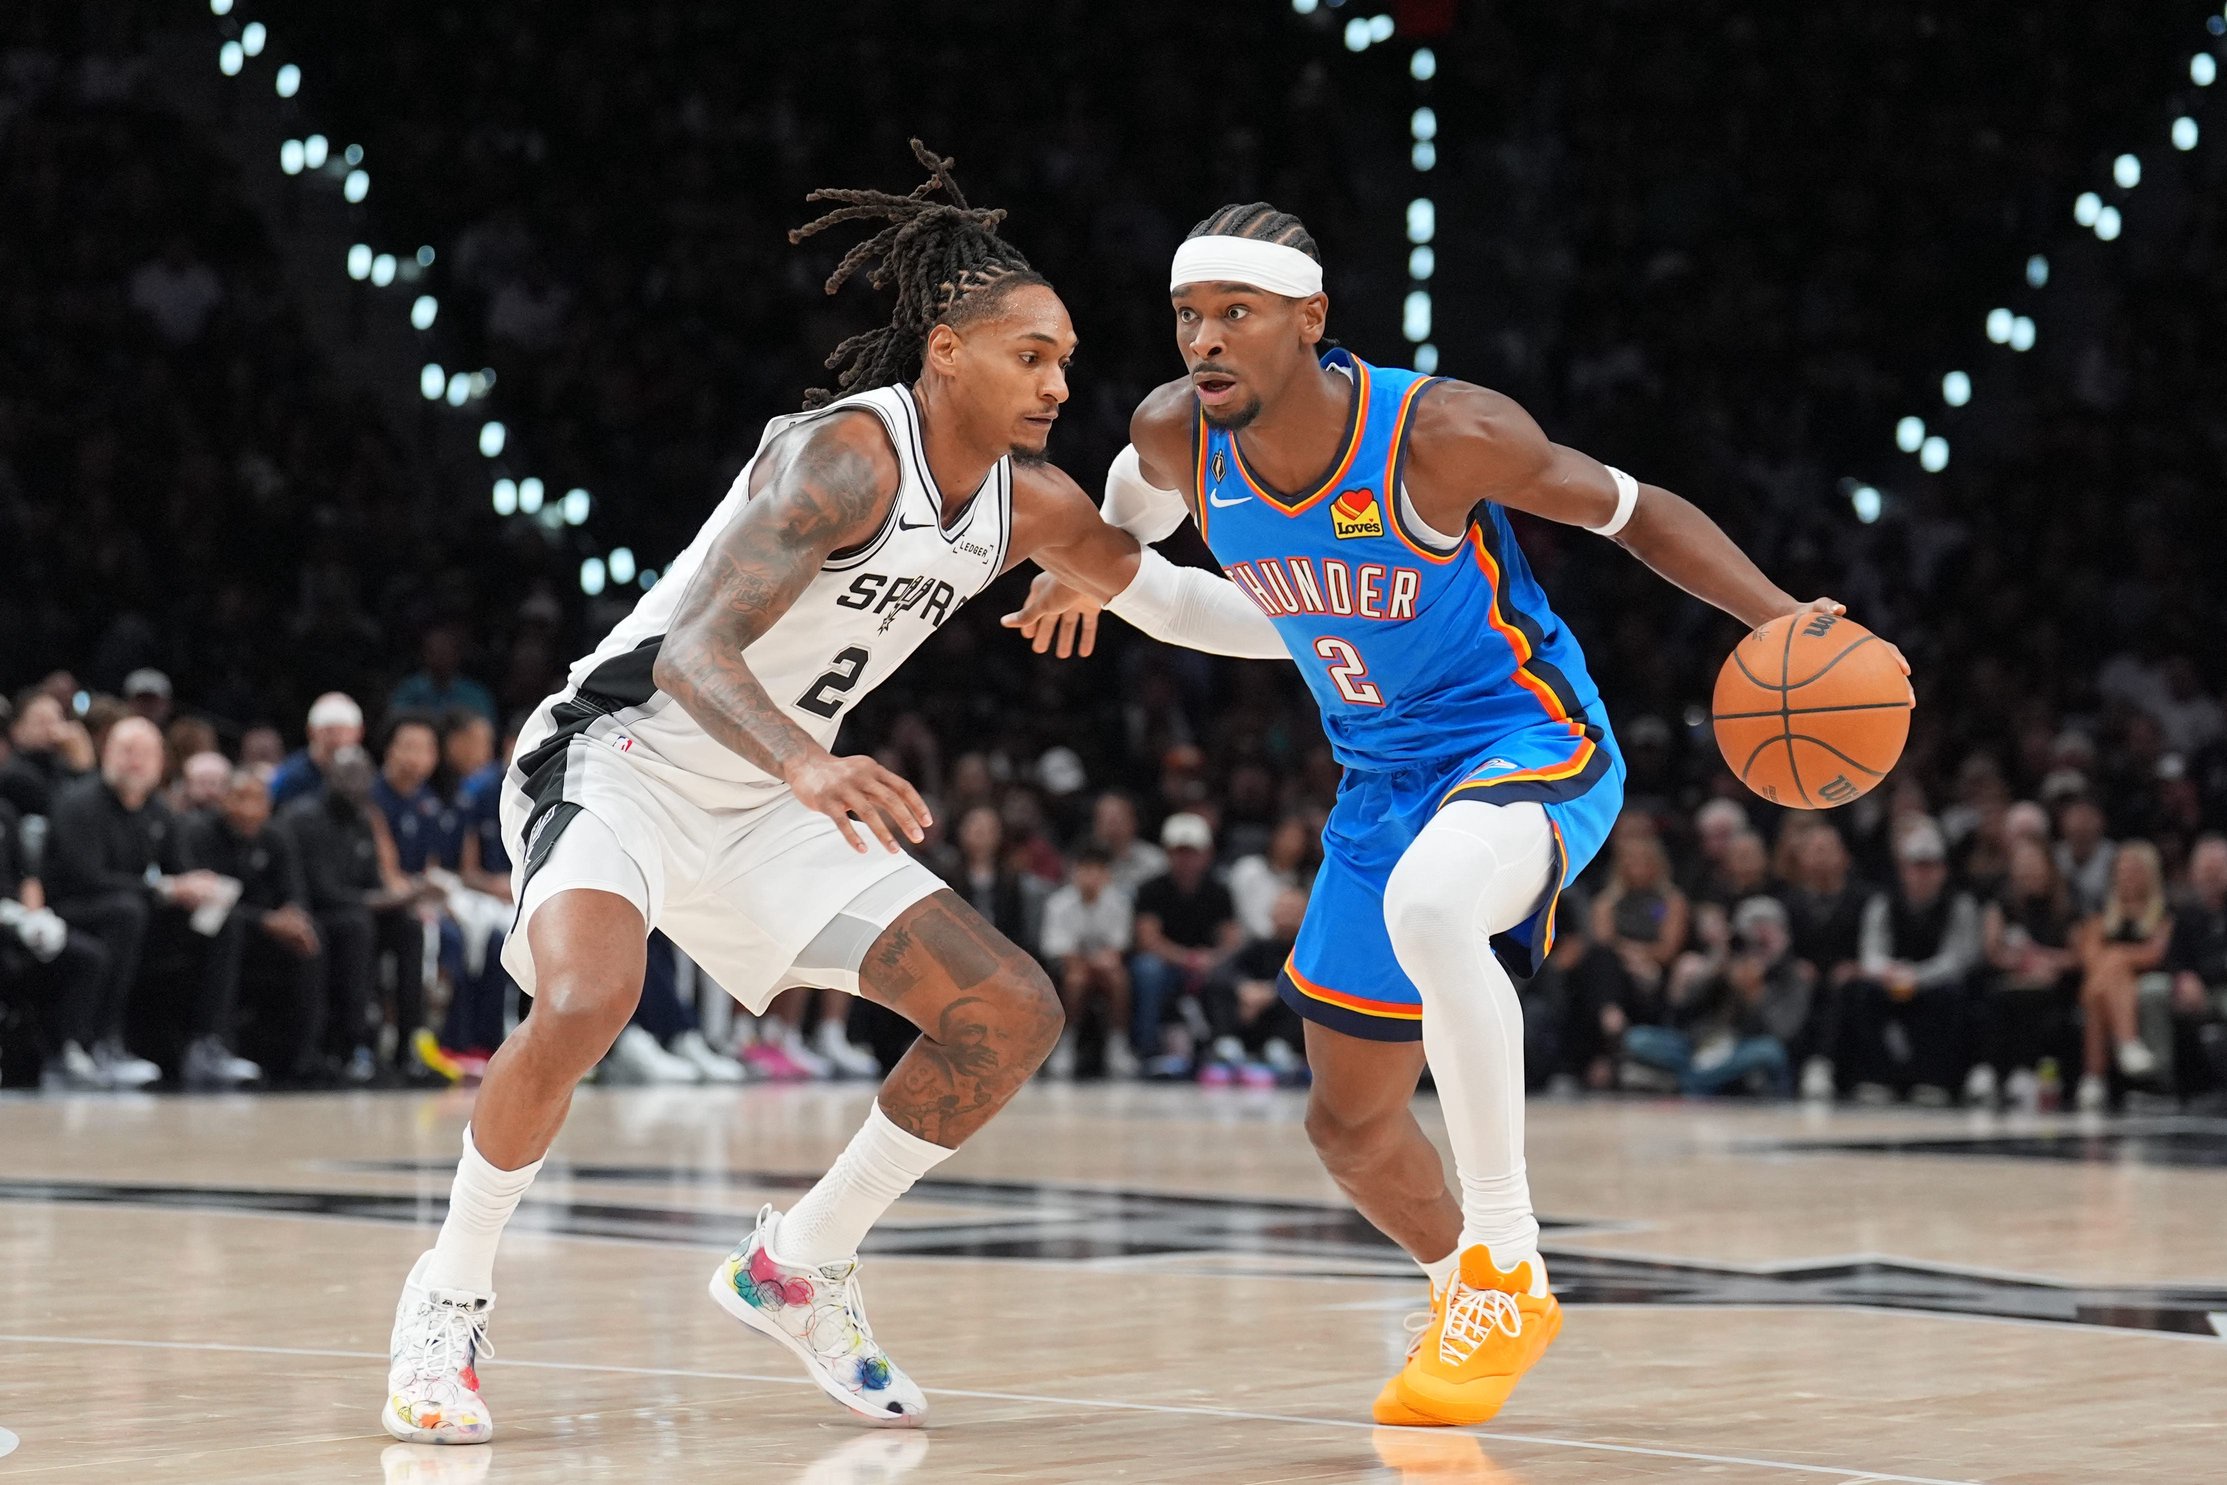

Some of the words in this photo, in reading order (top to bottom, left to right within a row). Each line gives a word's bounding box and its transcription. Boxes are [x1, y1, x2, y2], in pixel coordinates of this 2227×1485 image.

[959, 540, 988, 559] LEDGER
[836, 573, 969, 636] SPUR
[792, 643, 870, 721] 2
[1313, 635, 1386, 707] 2
